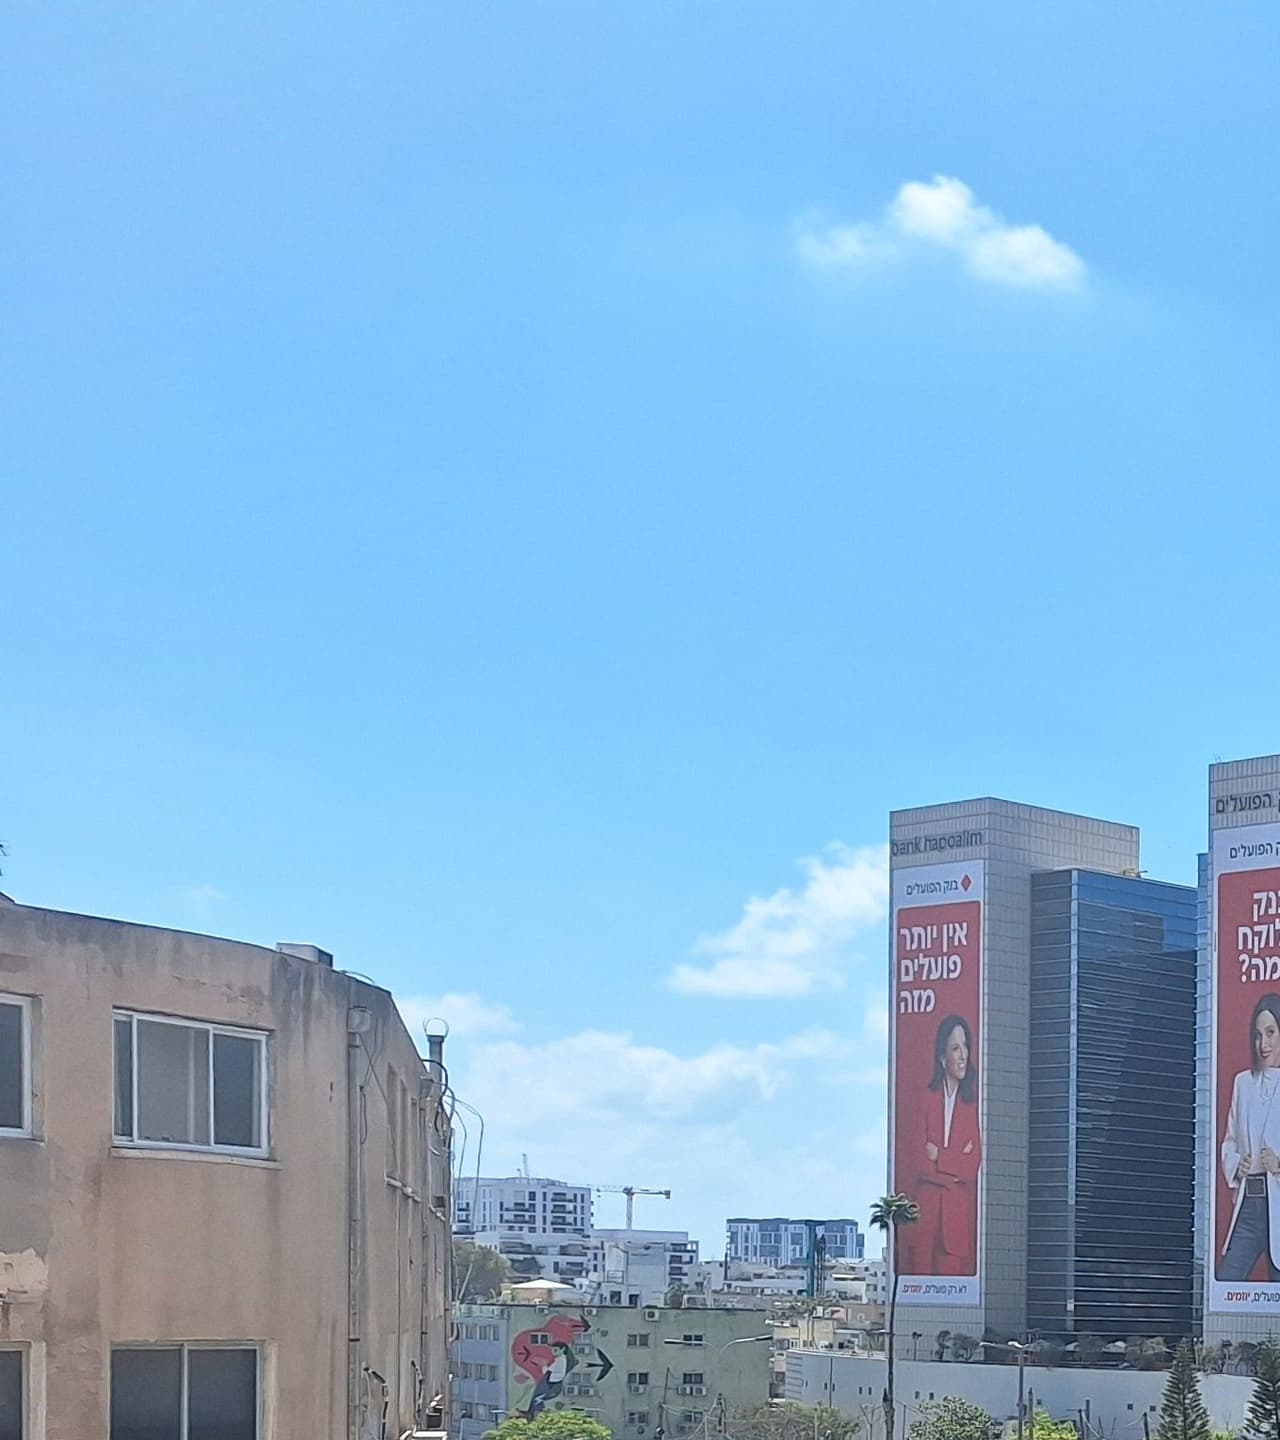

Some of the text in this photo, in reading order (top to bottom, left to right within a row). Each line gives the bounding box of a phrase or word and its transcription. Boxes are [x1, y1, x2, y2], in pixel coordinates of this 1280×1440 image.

[1215, 793, 1272, 814] הפועלים
[890, 830, 983, 856] bank hapoalim
[1229, 842, 1273, 859] הפועלים
[905, 880, 959, 896] בנק הפועלים
[900, 921, 968, 953] אין יותר
[900, 952, 962, 982] פועלים
[900, 988, 936, 1014] מזה
